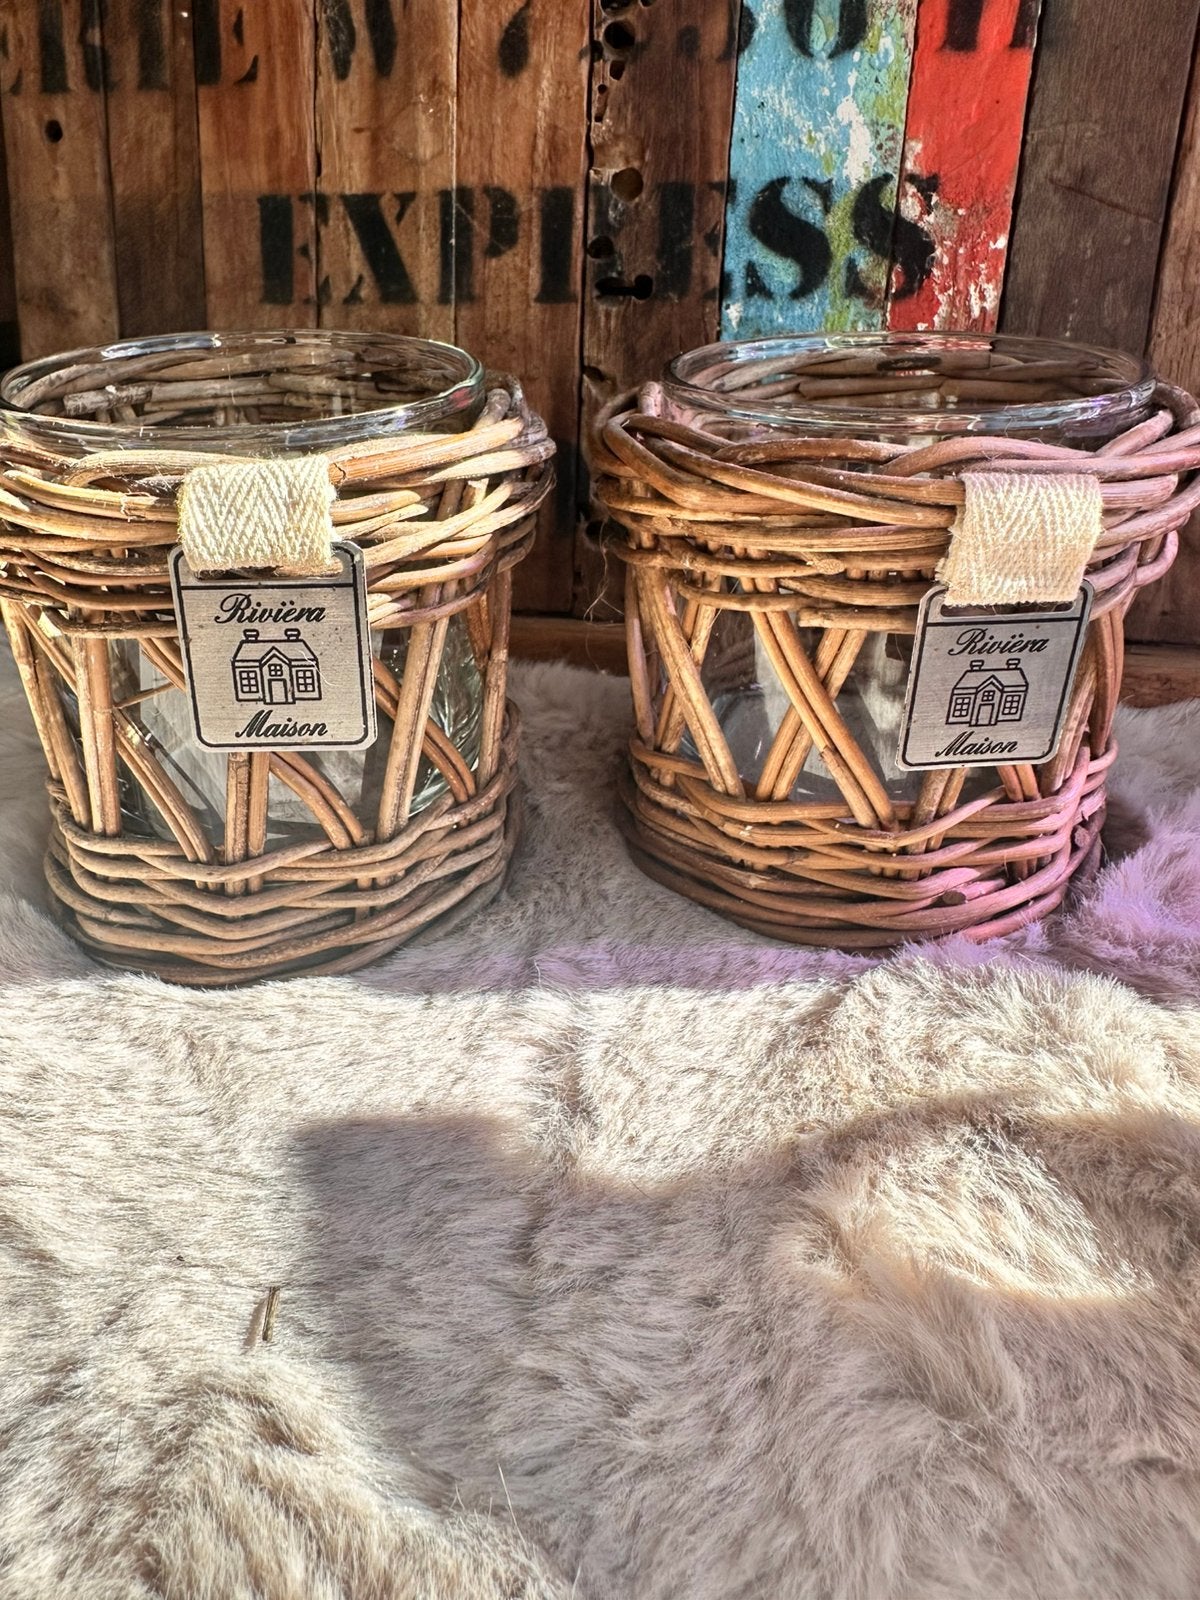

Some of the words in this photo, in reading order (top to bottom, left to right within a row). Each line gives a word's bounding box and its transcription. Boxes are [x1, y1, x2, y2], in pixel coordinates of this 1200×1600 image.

[214, 593, 326, 624] Riviëra
[948, 628, 1050, 655] Riviëra
[235, 709, 328, 738] Maison
[935, 731, 1018, 757] Maison
